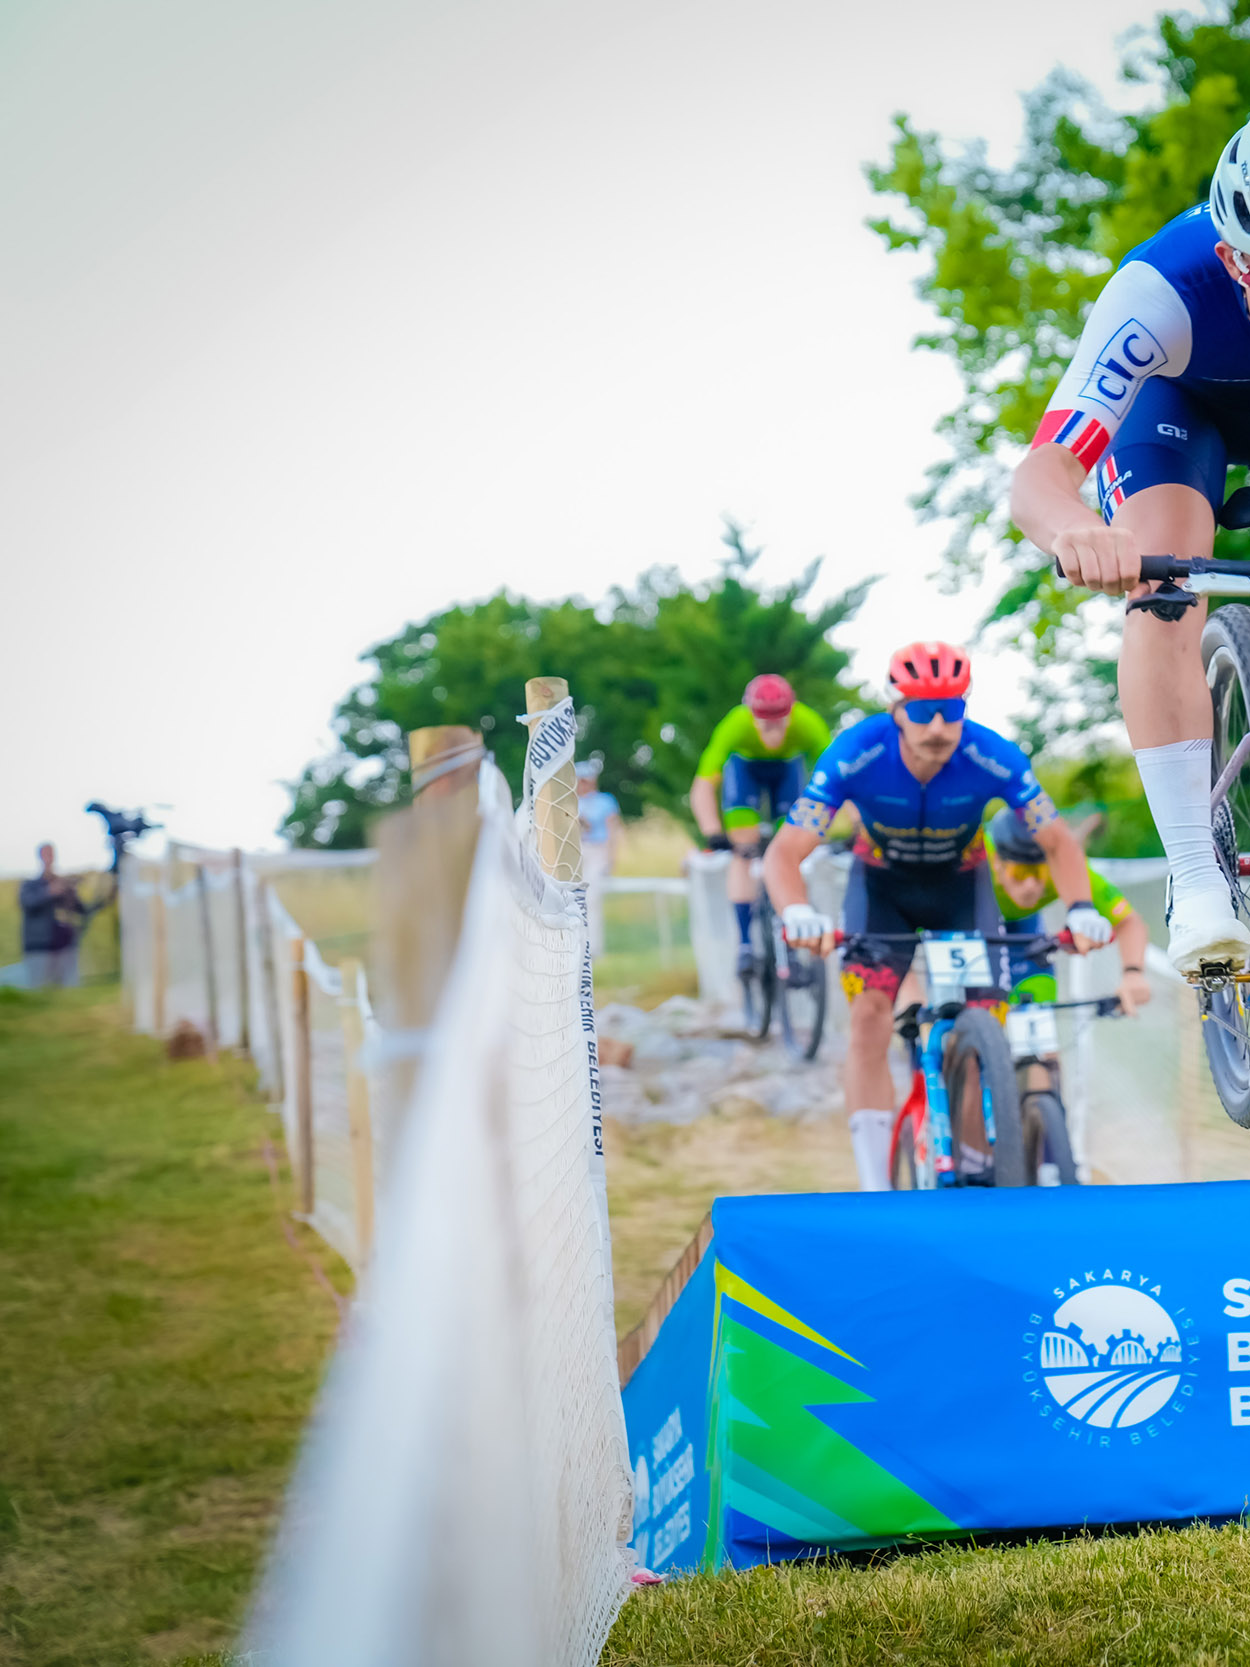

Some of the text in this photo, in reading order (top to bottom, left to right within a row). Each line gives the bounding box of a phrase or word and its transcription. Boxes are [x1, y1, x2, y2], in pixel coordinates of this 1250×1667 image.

[1097, 333, 1155, 401] CIC
[949, 948, 966, 968] 5
[1052, 1268, 1162, 1300] SAKARYA
